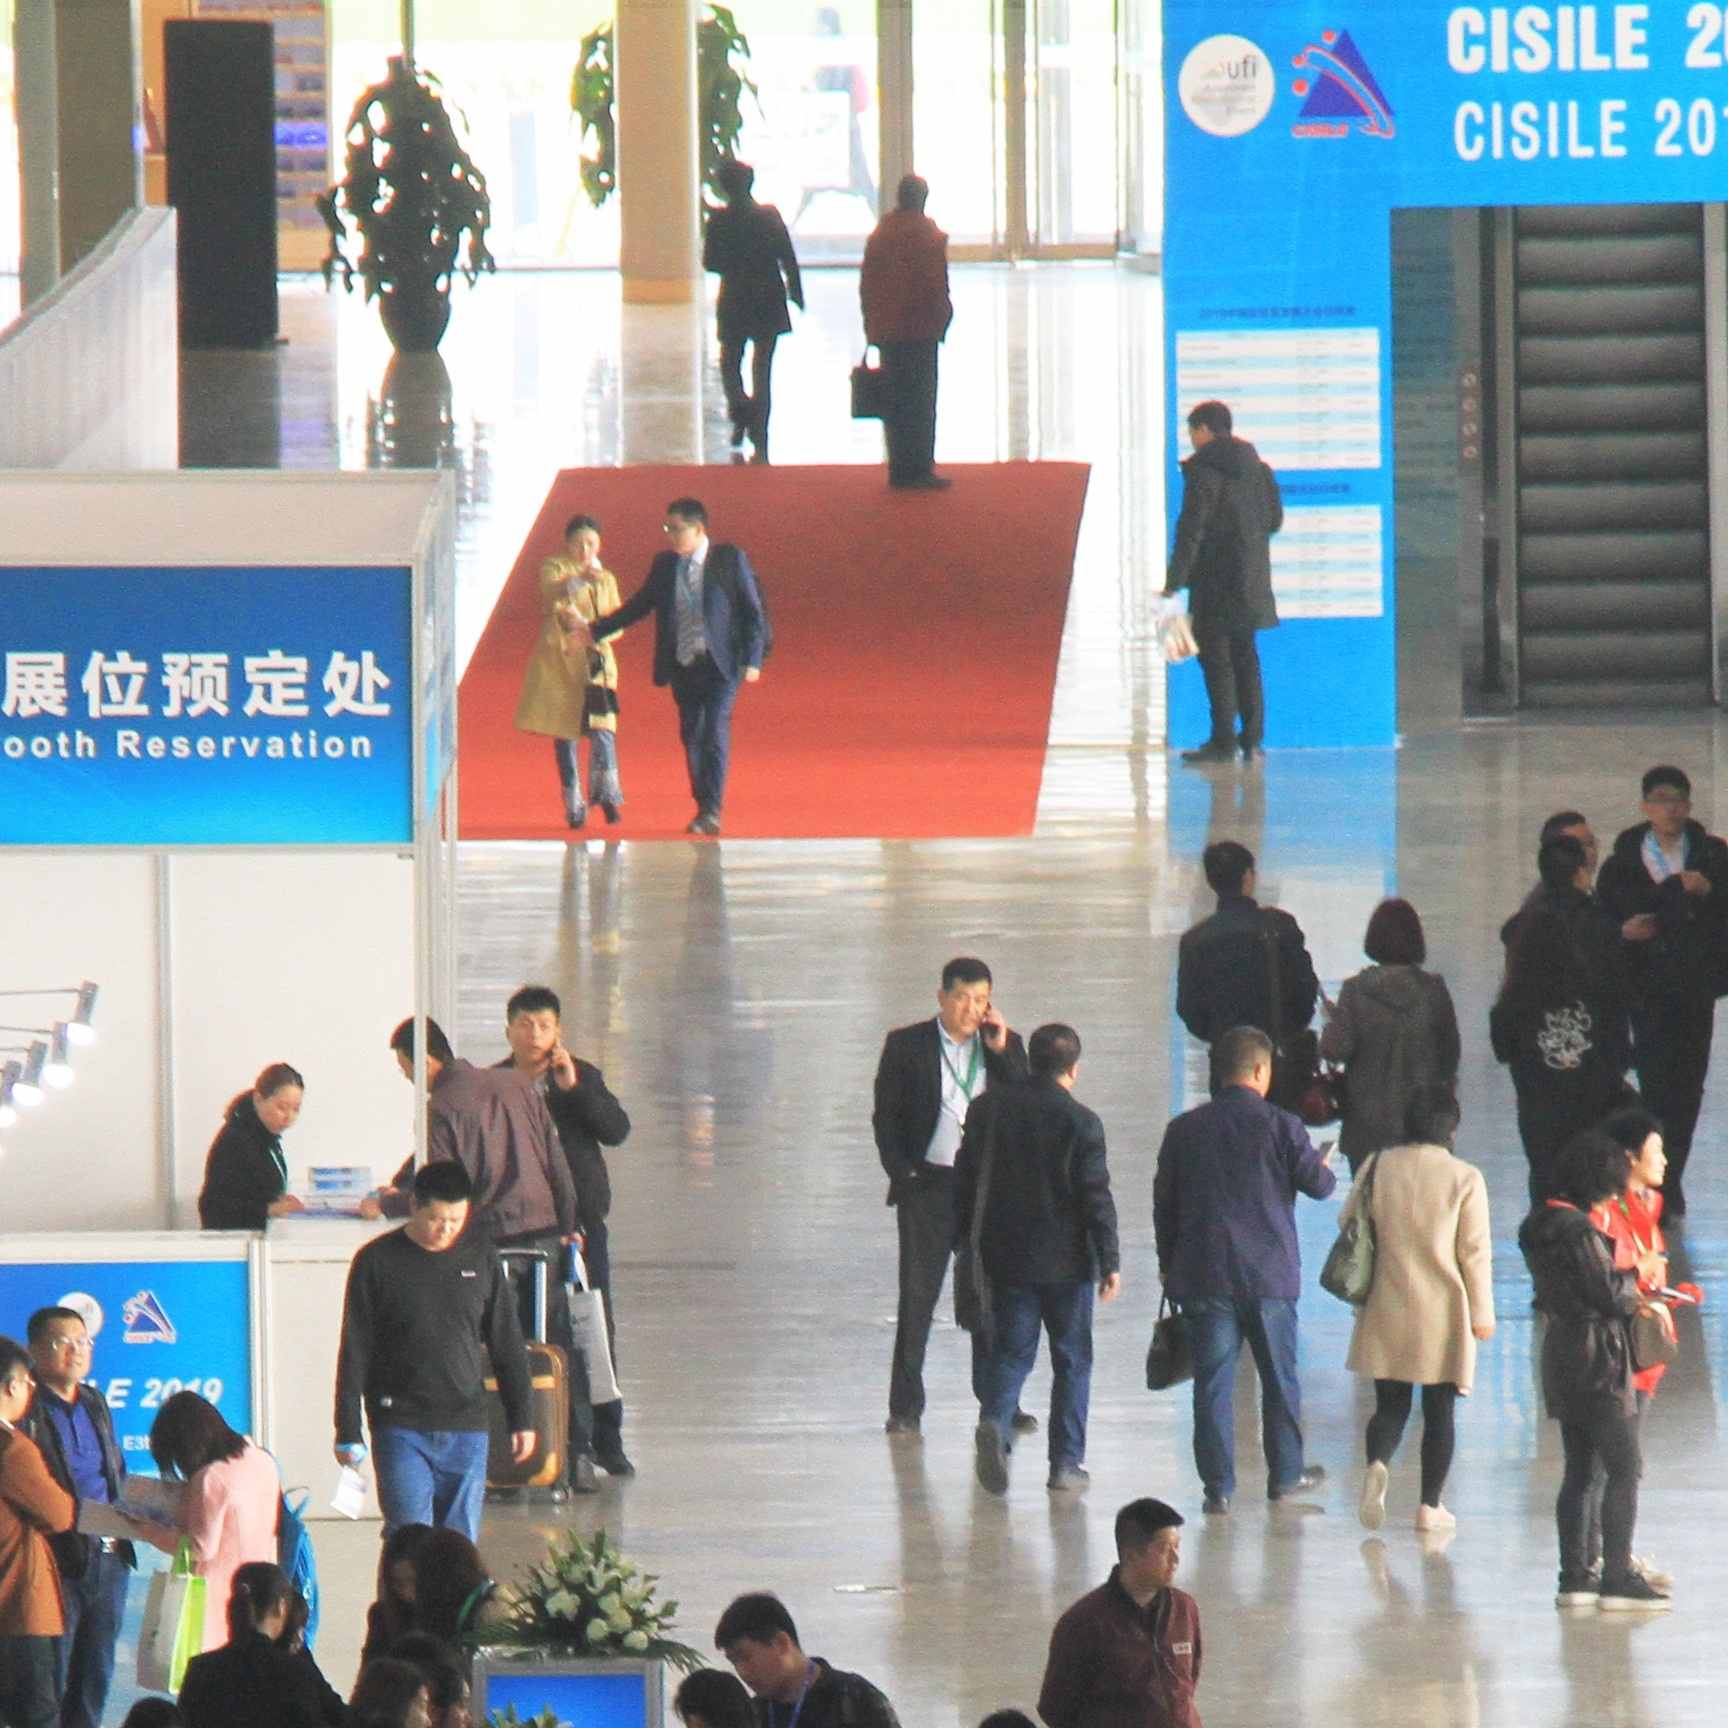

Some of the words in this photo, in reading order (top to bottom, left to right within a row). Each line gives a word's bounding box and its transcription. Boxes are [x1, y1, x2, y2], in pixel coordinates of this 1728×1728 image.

[1447, 5, 1650, 74] CISILE
[1455, 100, 1628, 161] CISILE
[117, 730, 372, 760] Reservation
